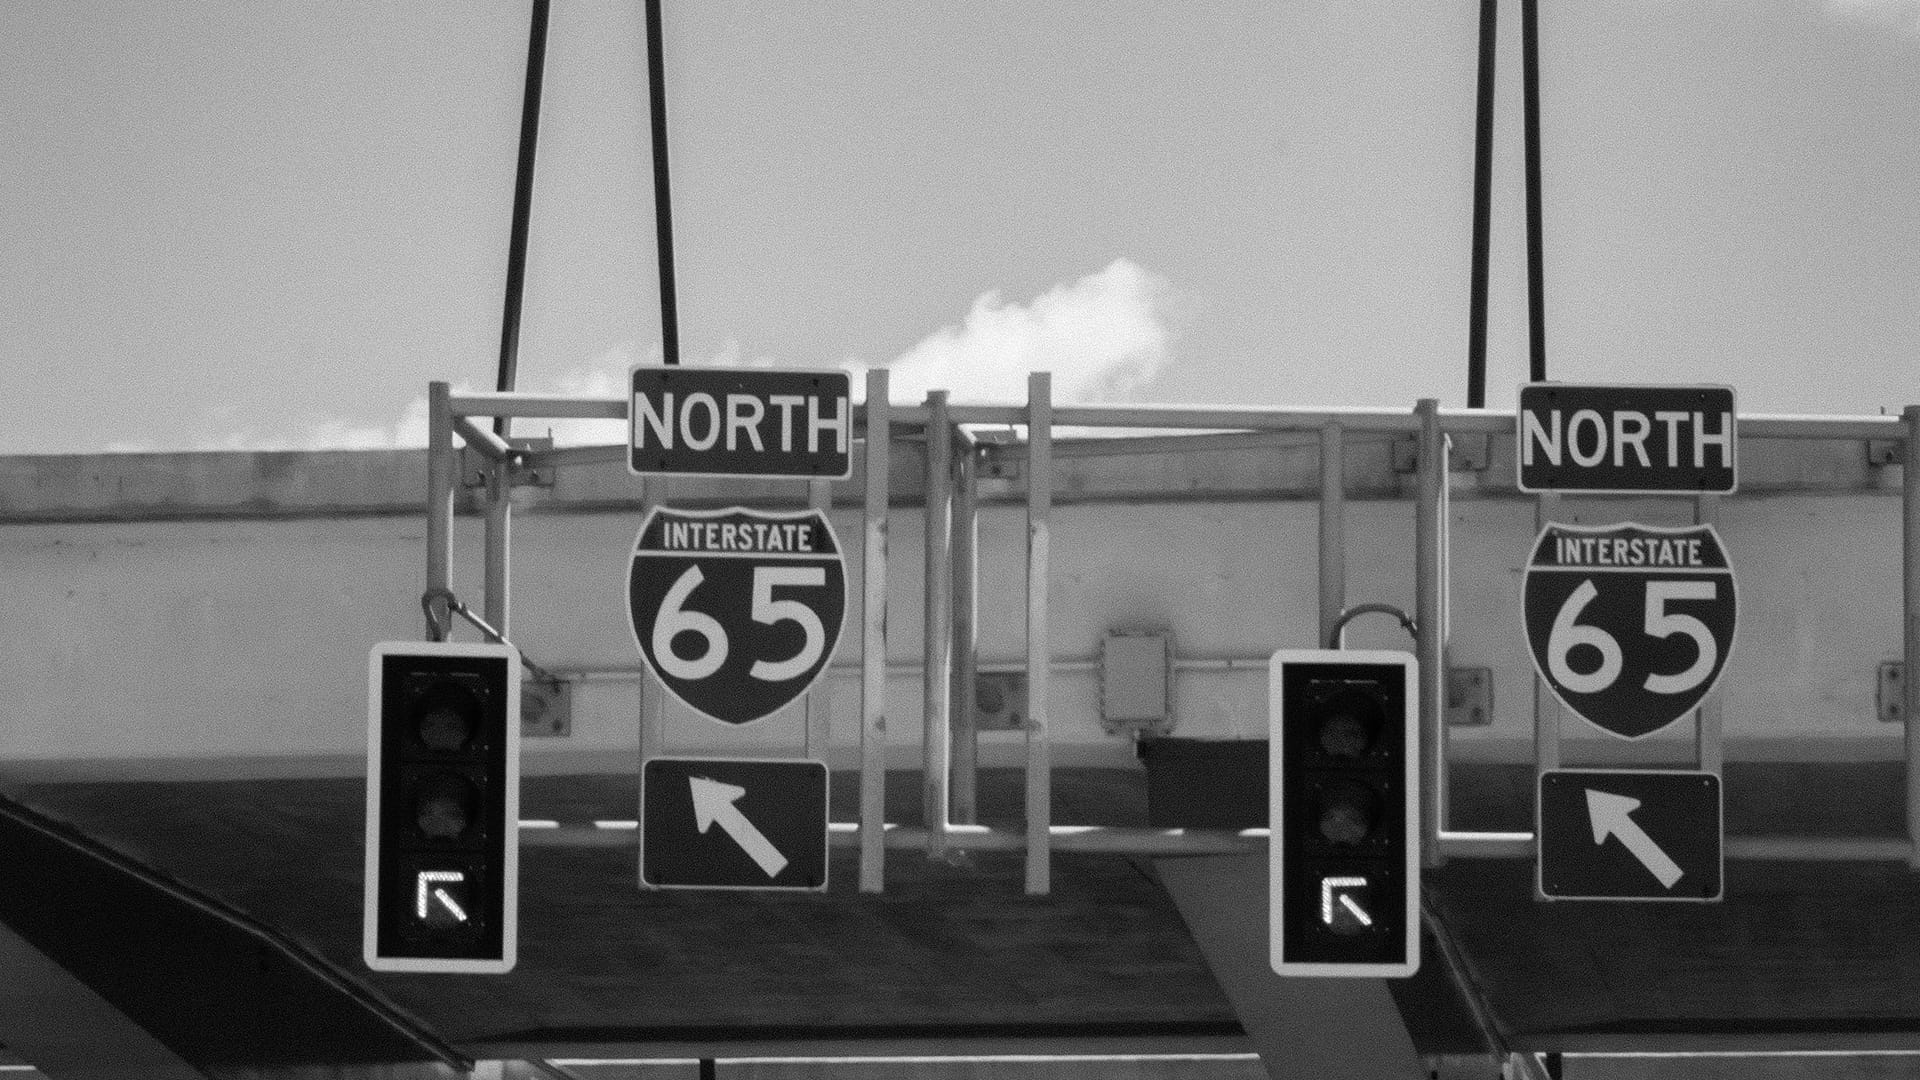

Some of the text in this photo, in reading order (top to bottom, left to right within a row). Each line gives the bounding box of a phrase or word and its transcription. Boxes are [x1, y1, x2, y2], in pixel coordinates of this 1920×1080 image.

[633, 391, 848, 454] NORTH
[1522, 409, 1733, 468] NORTH
[663, 522, 812, 552] INTERSTATE
[1556, 538, 1703, 565] INTERSTATE
[652, 564, 826, 682] 65
[1547, 579, 1718, 695] 65
